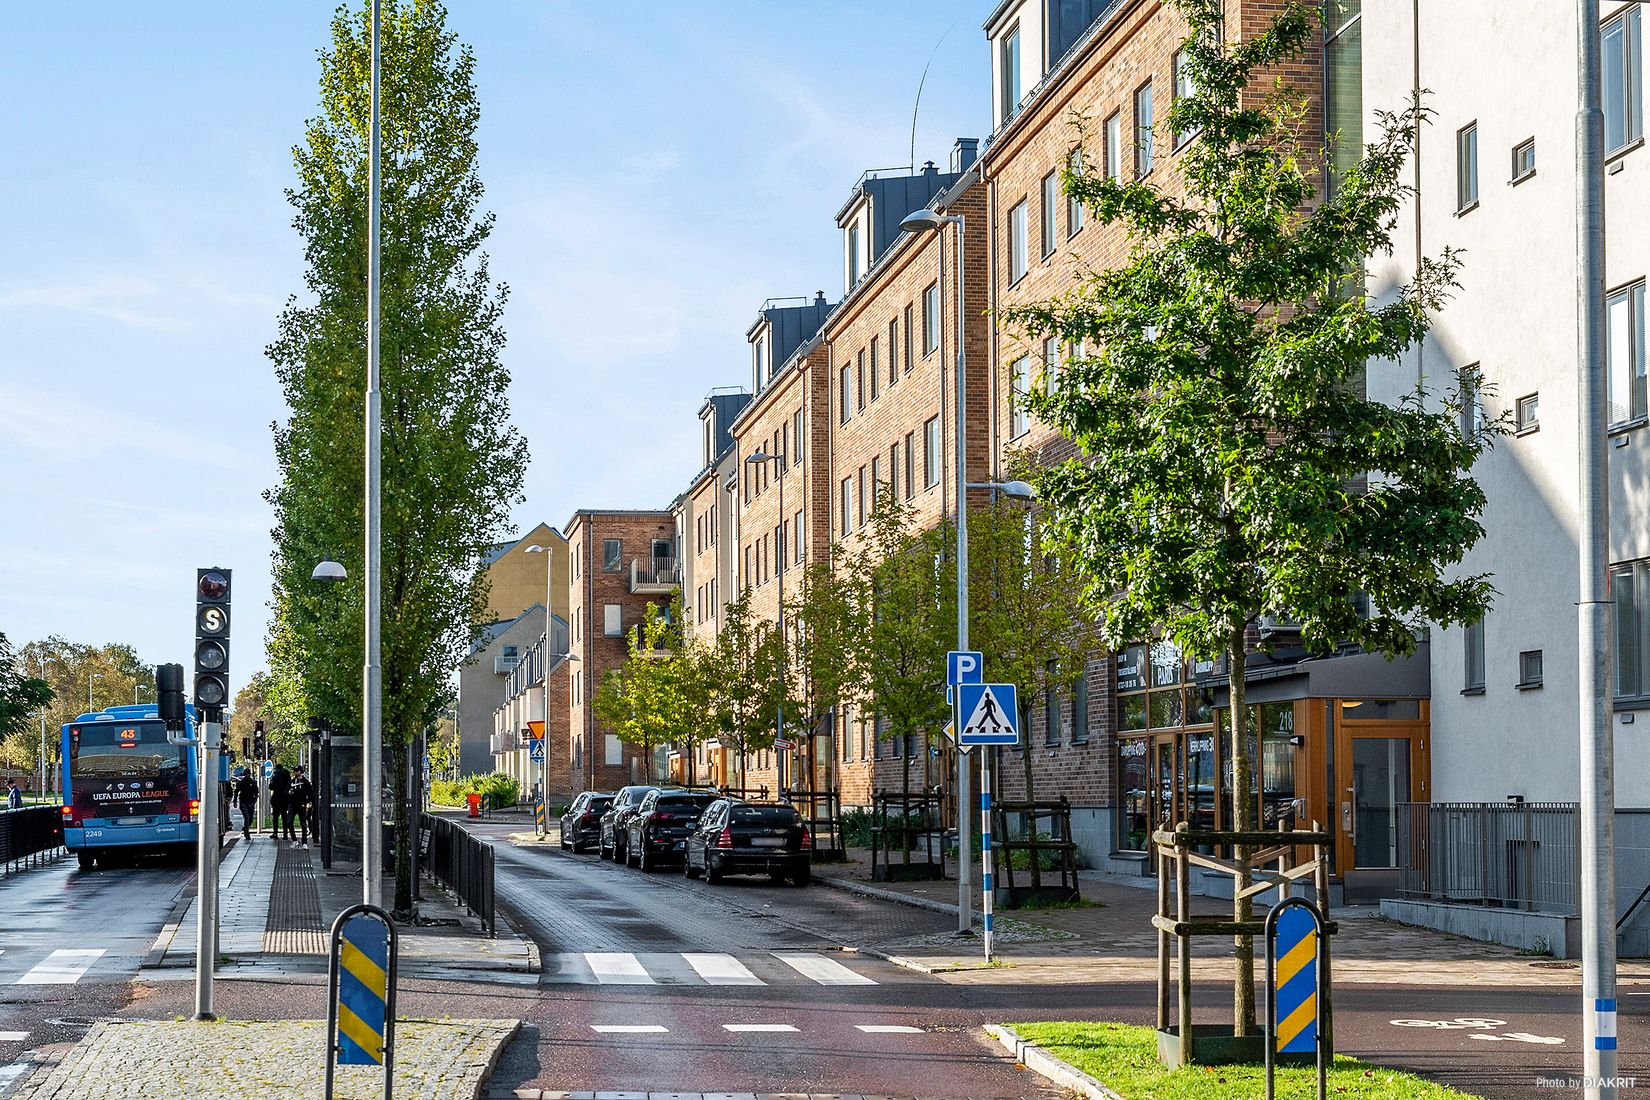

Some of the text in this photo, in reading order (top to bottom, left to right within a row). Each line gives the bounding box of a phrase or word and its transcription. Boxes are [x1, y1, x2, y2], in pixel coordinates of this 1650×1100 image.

[957, 655, 976, 683] P
[1279, 711, 1293, 731] 218
[121, 730, 135, 738] 43
[112, 792, 140, 800] EUROPA
